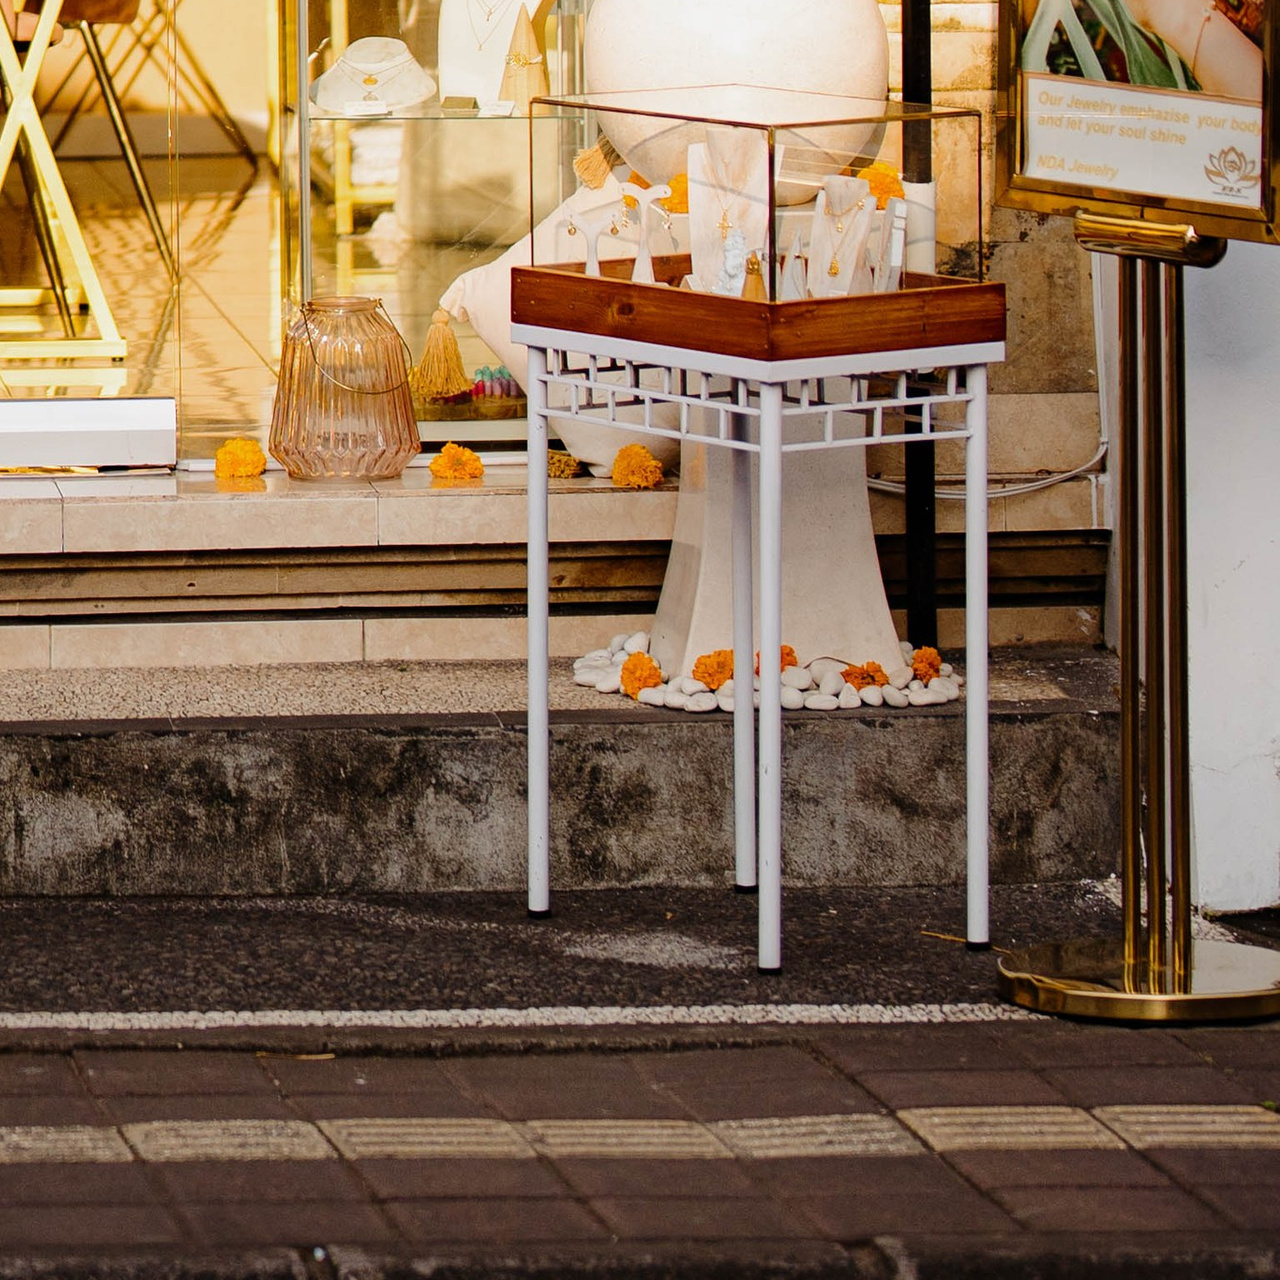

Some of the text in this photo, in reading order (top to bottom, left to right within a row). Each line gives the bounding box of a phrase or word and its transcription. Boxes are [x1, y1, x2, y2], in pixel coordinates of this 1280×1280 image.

[1038, 91, 1064, 106] Our
[1066, 94, 1116, 115] Jewelry
[1120, 104, 1190, 124] emphazise
[1197, 114, 1227, 130] your
[1037, 113, 1187, 145] and let your soul shine
[1036, 154, 1120, 181] NDA Jewelry
